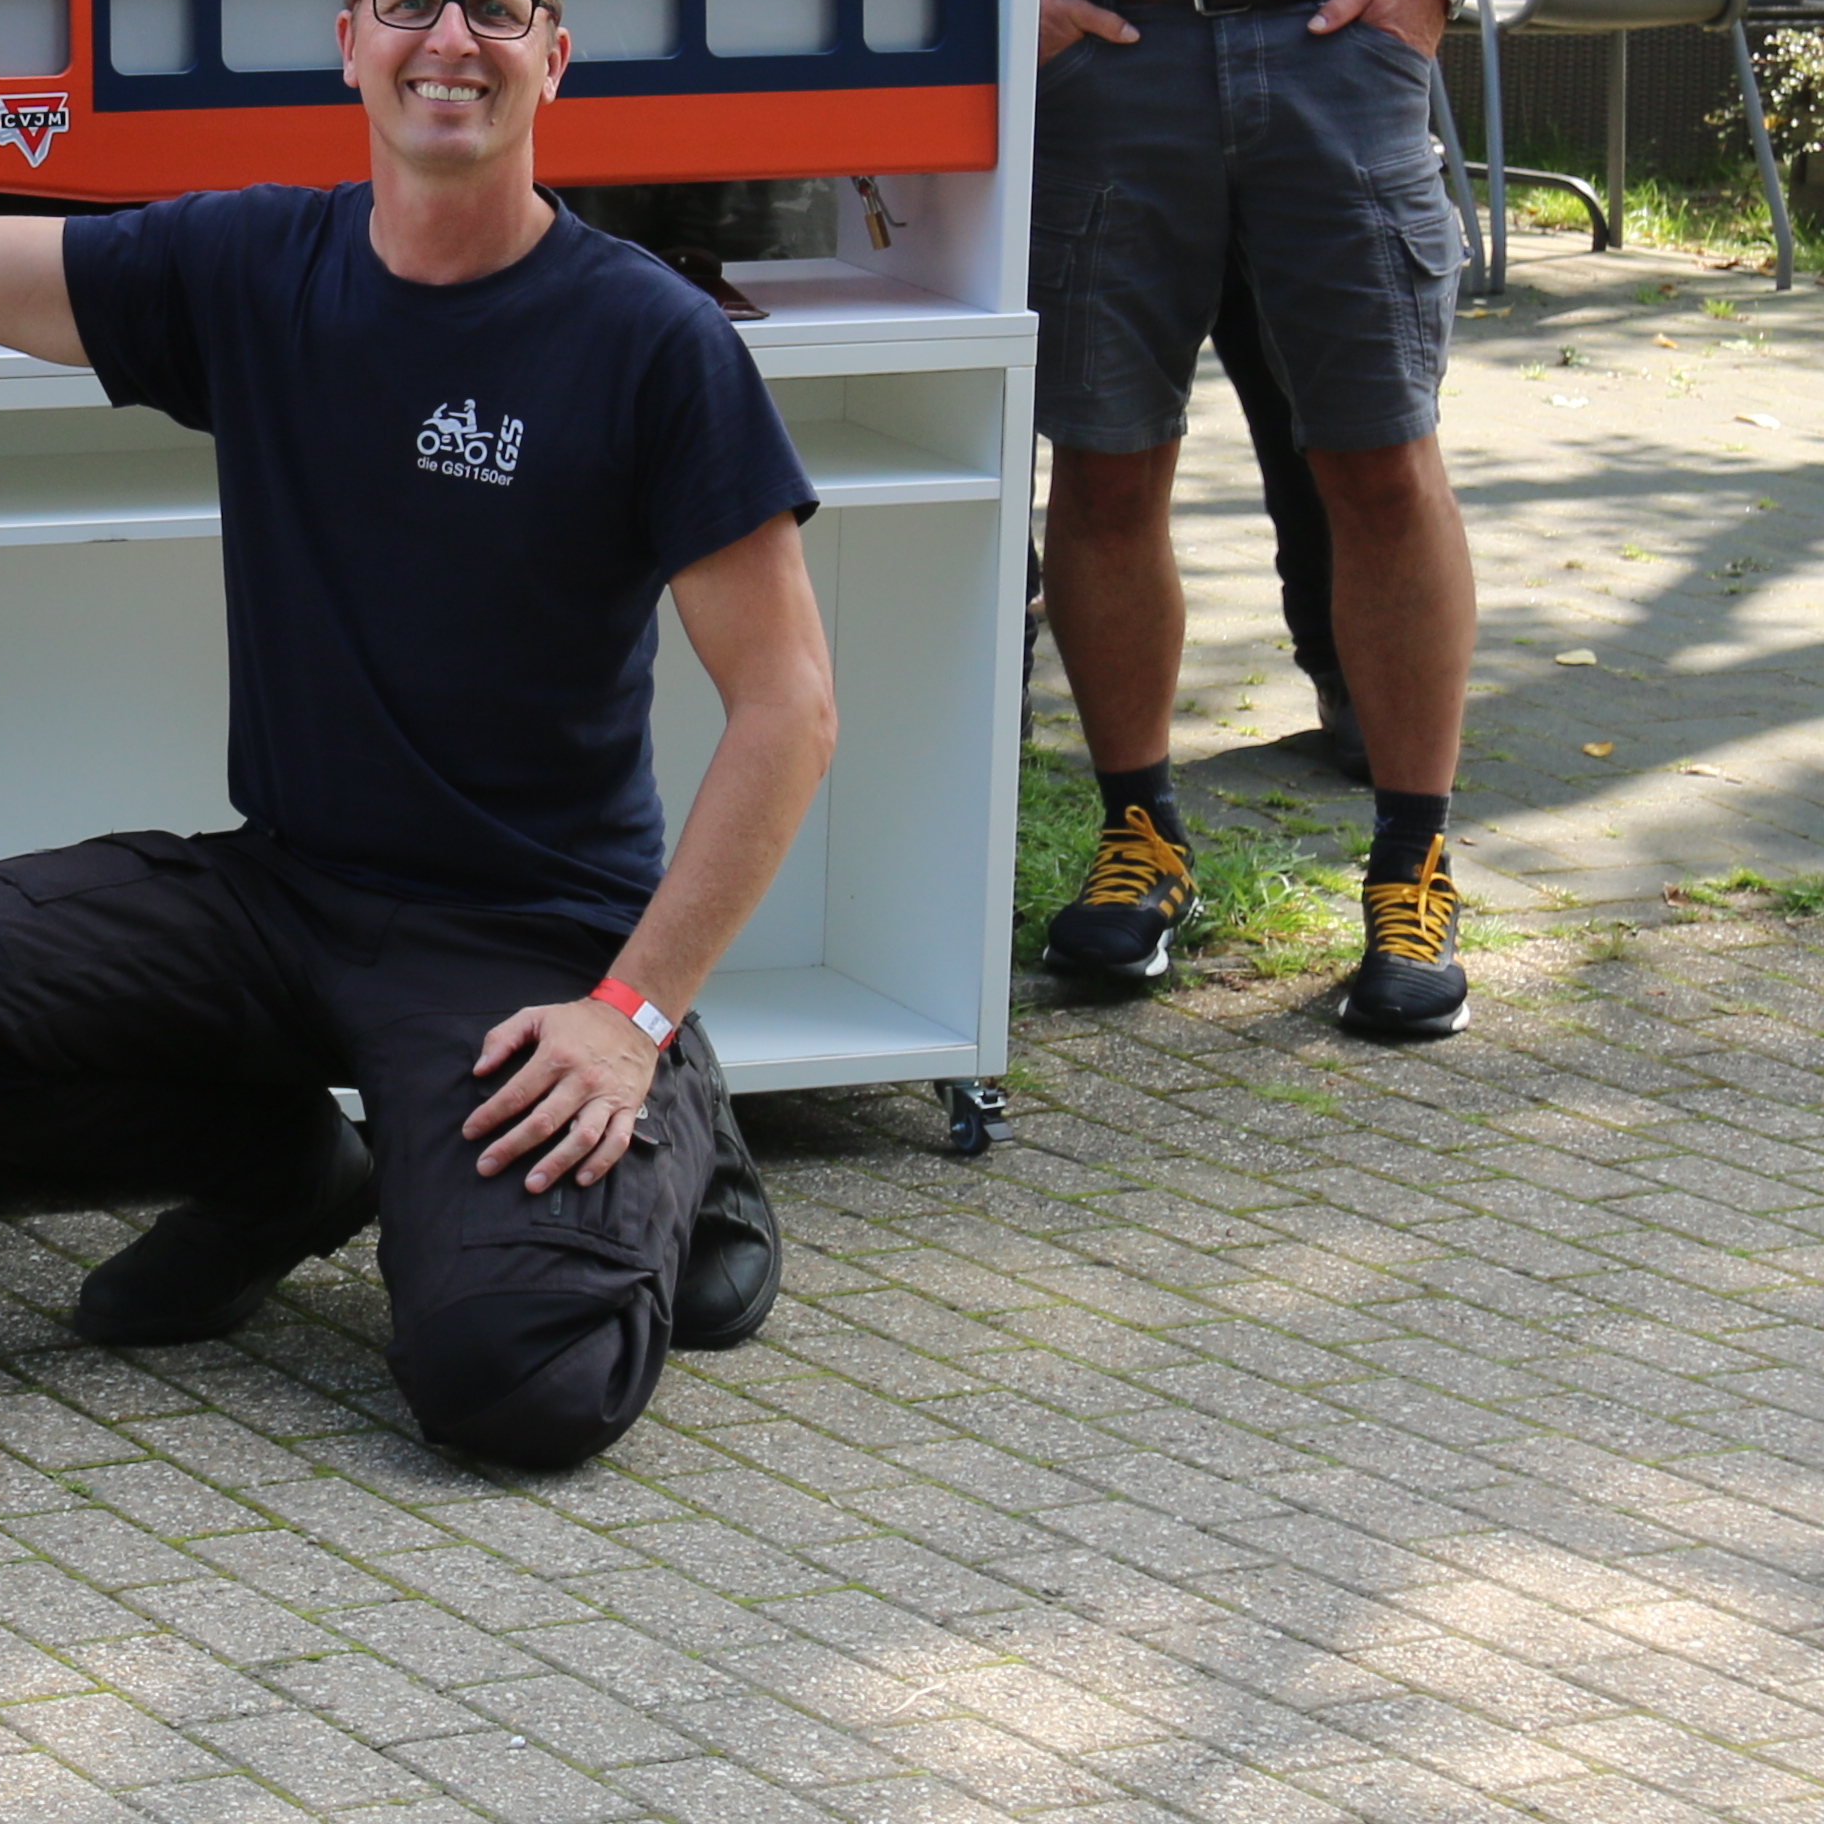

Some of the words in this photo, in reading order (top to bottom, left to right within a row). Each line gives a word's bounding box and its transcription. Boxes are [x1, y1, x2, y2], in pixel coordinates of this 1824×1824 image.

[4, 112, 62, 128] CVJM
[495, 414, 524, 472] GS
[417, 457, 438, 472] die
[441, 460, 514, 487] GS1150er
